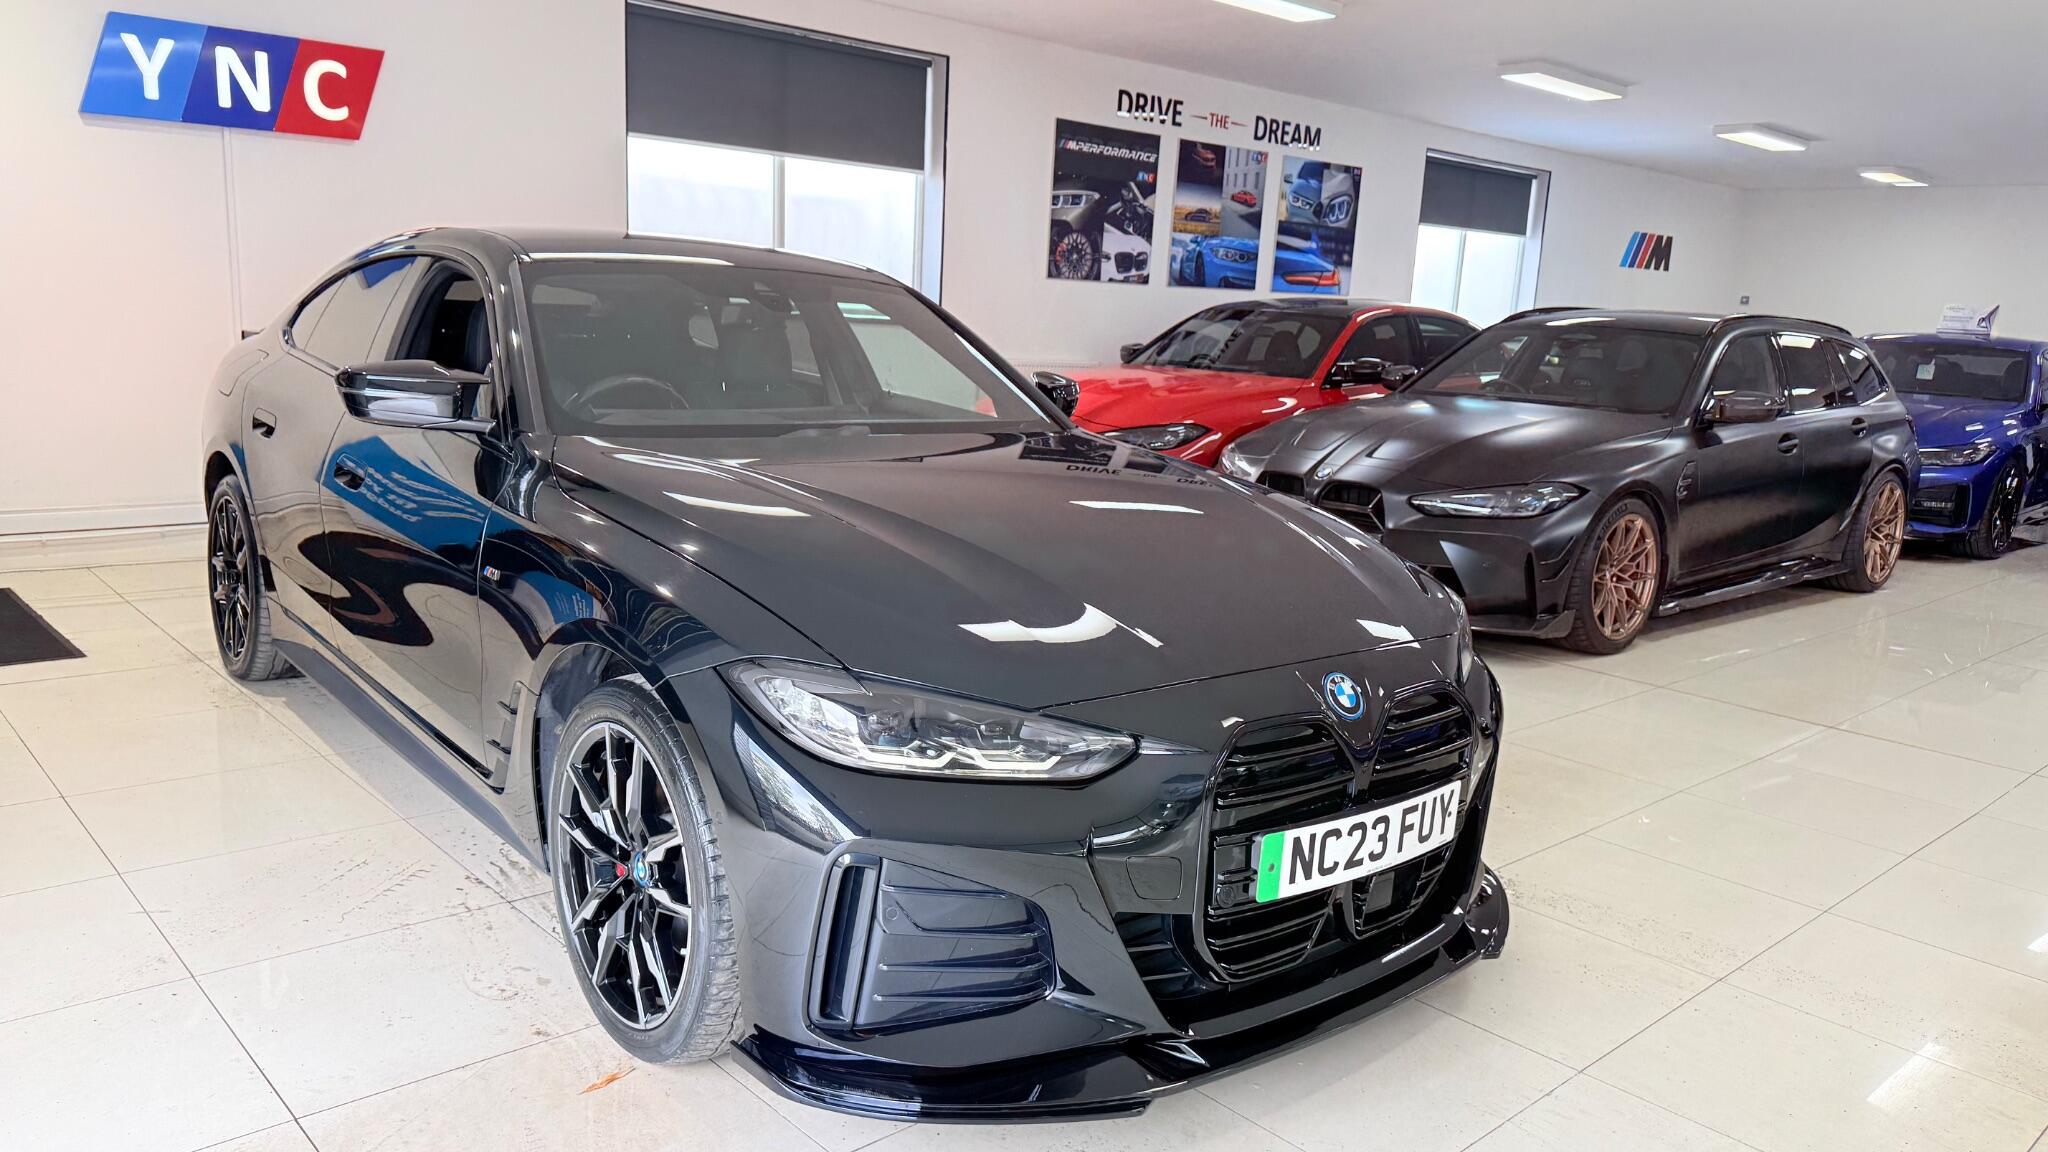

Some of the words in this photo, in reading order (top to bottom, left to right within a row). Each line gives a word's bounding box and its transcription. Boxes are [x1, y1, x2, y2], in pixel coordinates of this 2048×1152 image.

[120, 32, 349, 121] YNC
[1117, 88, 1184, 127] DRIVE
[1209, 112, 1230, 130] THE
[1253, 115, 1322, 151] DREAM
[1288, 814, 1391, 885] NC23
[1397, 789, 1455, 853] FUY
